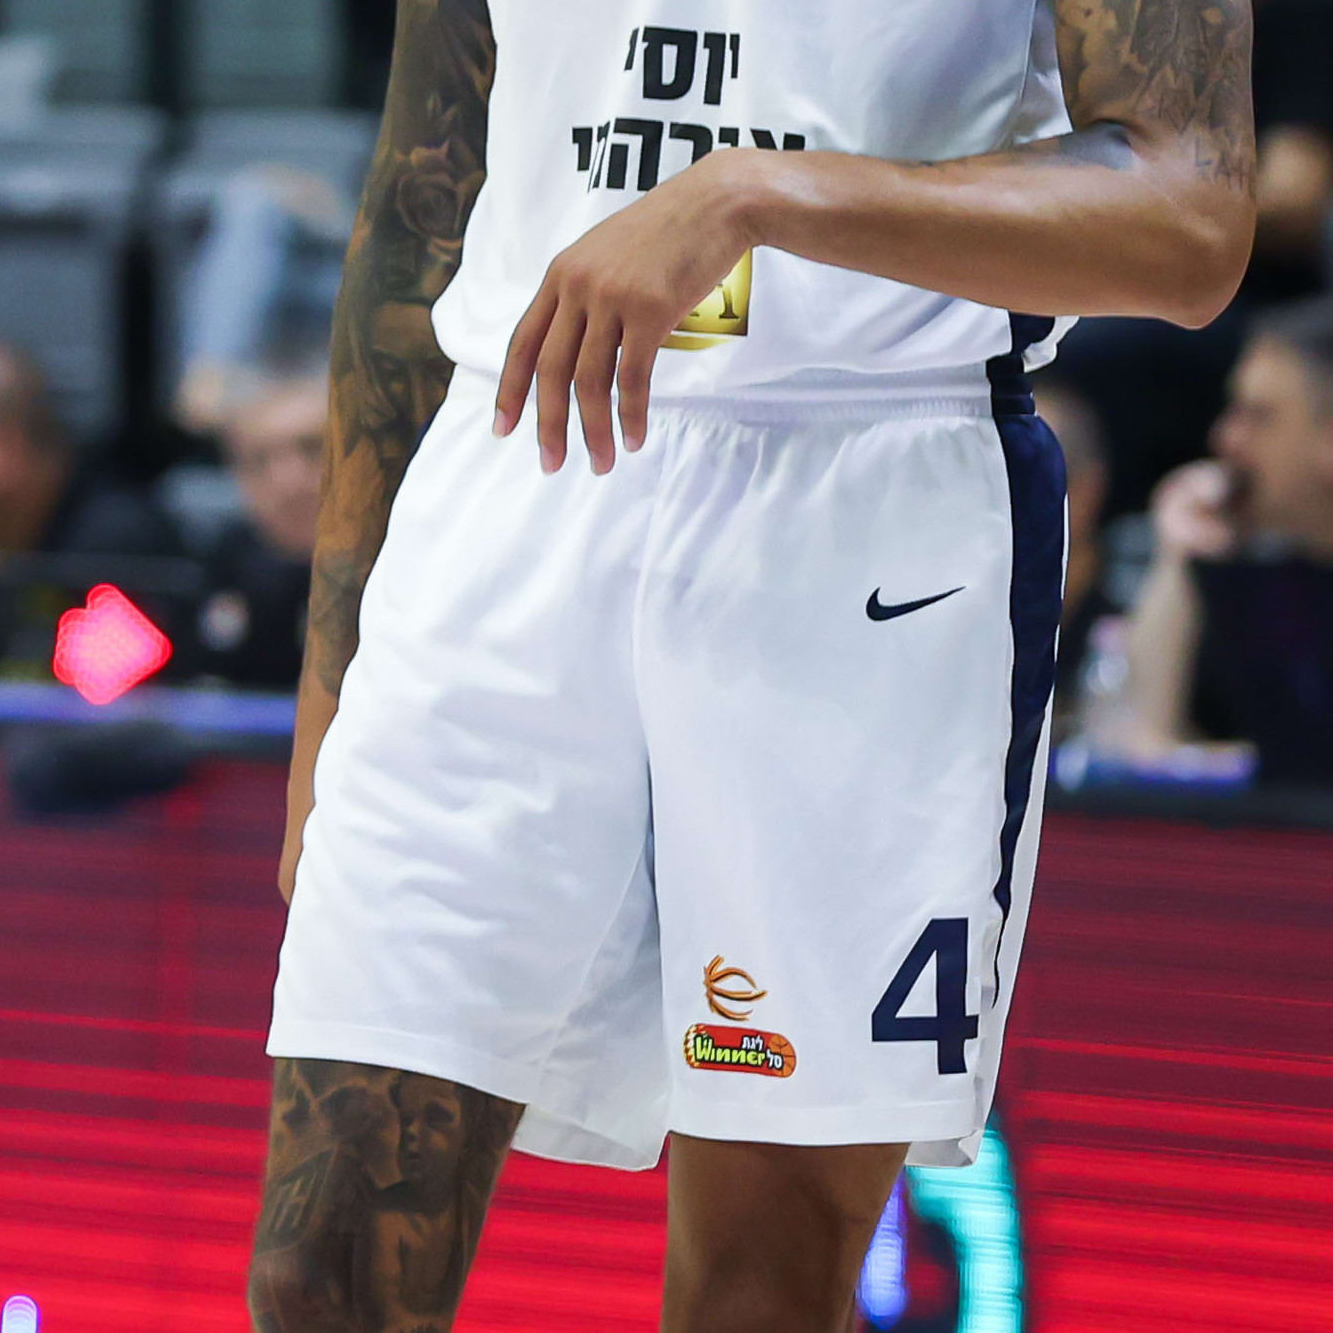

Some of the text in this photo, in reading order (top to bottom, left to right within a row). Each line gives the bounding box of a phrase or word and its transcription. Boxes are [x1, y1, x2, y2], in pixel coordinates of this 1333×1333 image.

[623, 25, 741, 107] יוסי
[871, 917, 980, 1075] 4
[695, 1035, 766, 1066] Winner
[766, 1048, 783, 1069] סל
